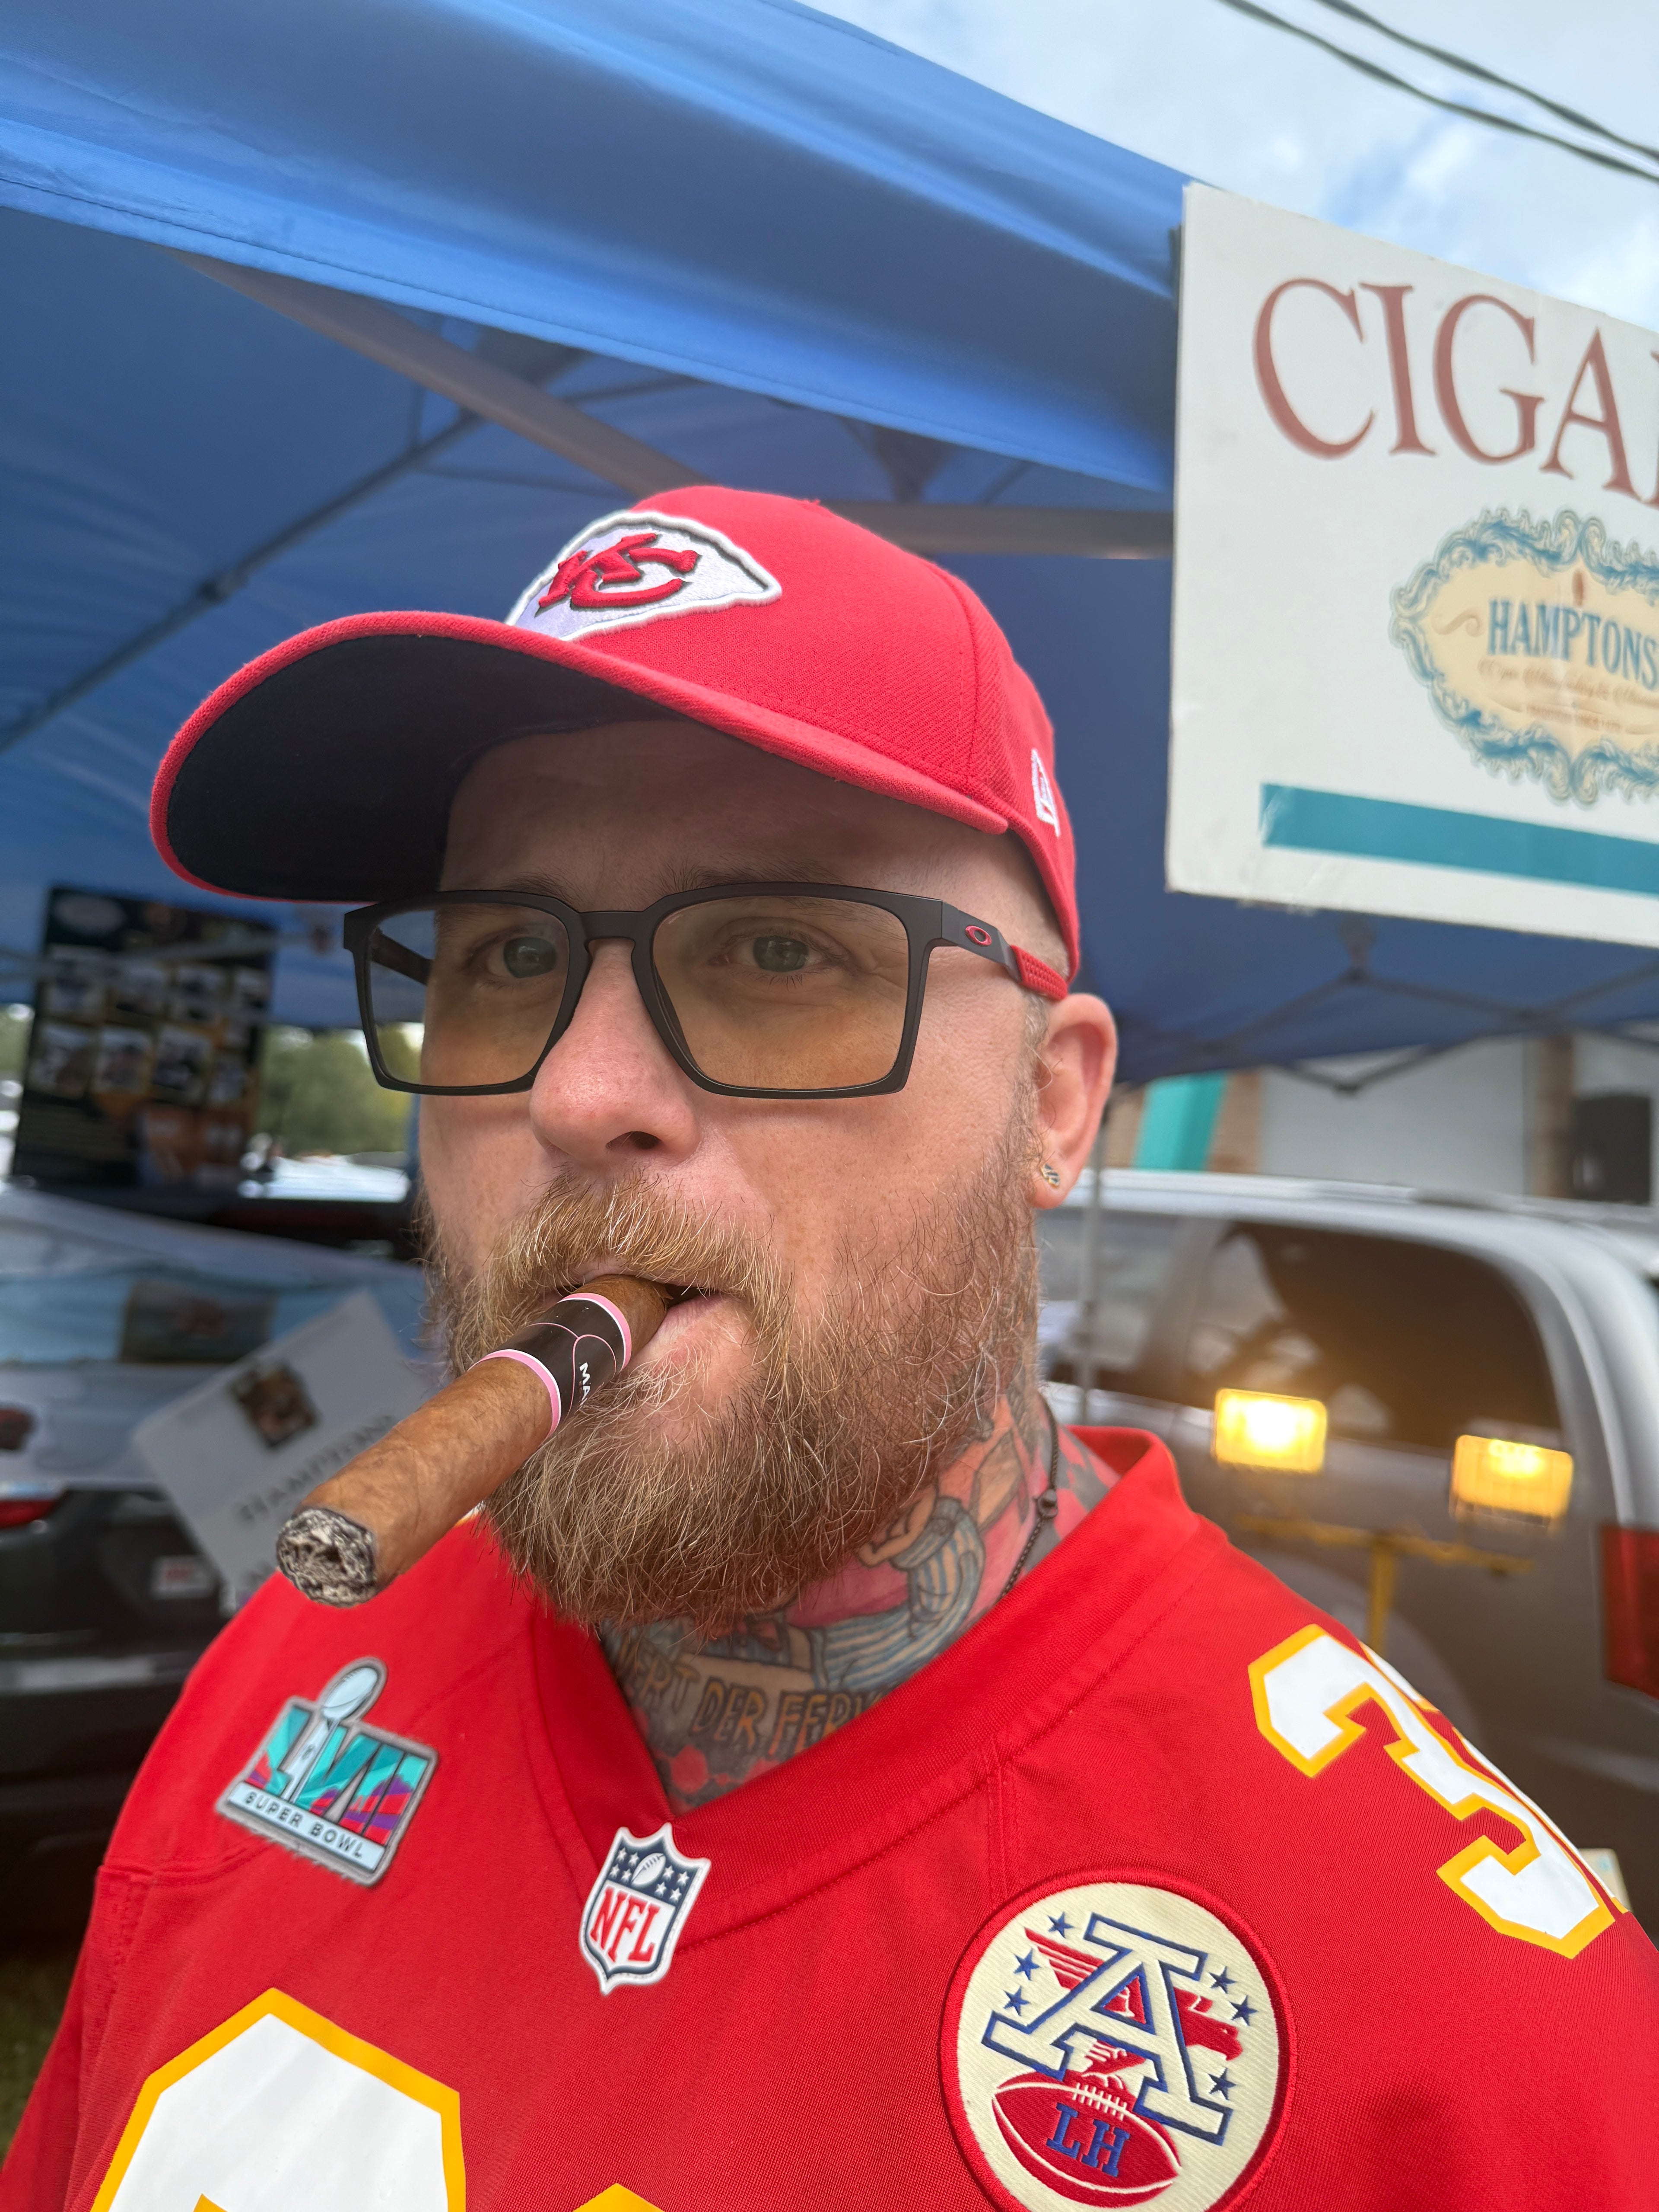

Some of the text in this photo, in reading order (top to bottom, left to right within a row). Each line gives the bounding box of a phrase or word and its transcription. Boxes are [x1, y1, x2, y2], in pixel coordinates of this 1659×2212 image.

[1252, 276, 1659, 509] CIGA
[1487, 597, 1659, 691] HAMPTONS
[244, 1791, 363, 1859] SUPER BOWL
[1247, 1623, 1628, 1960] 3
[590, 1886, 661, 1963] NFL
[1046, 2102, 1131, 2178] LH
